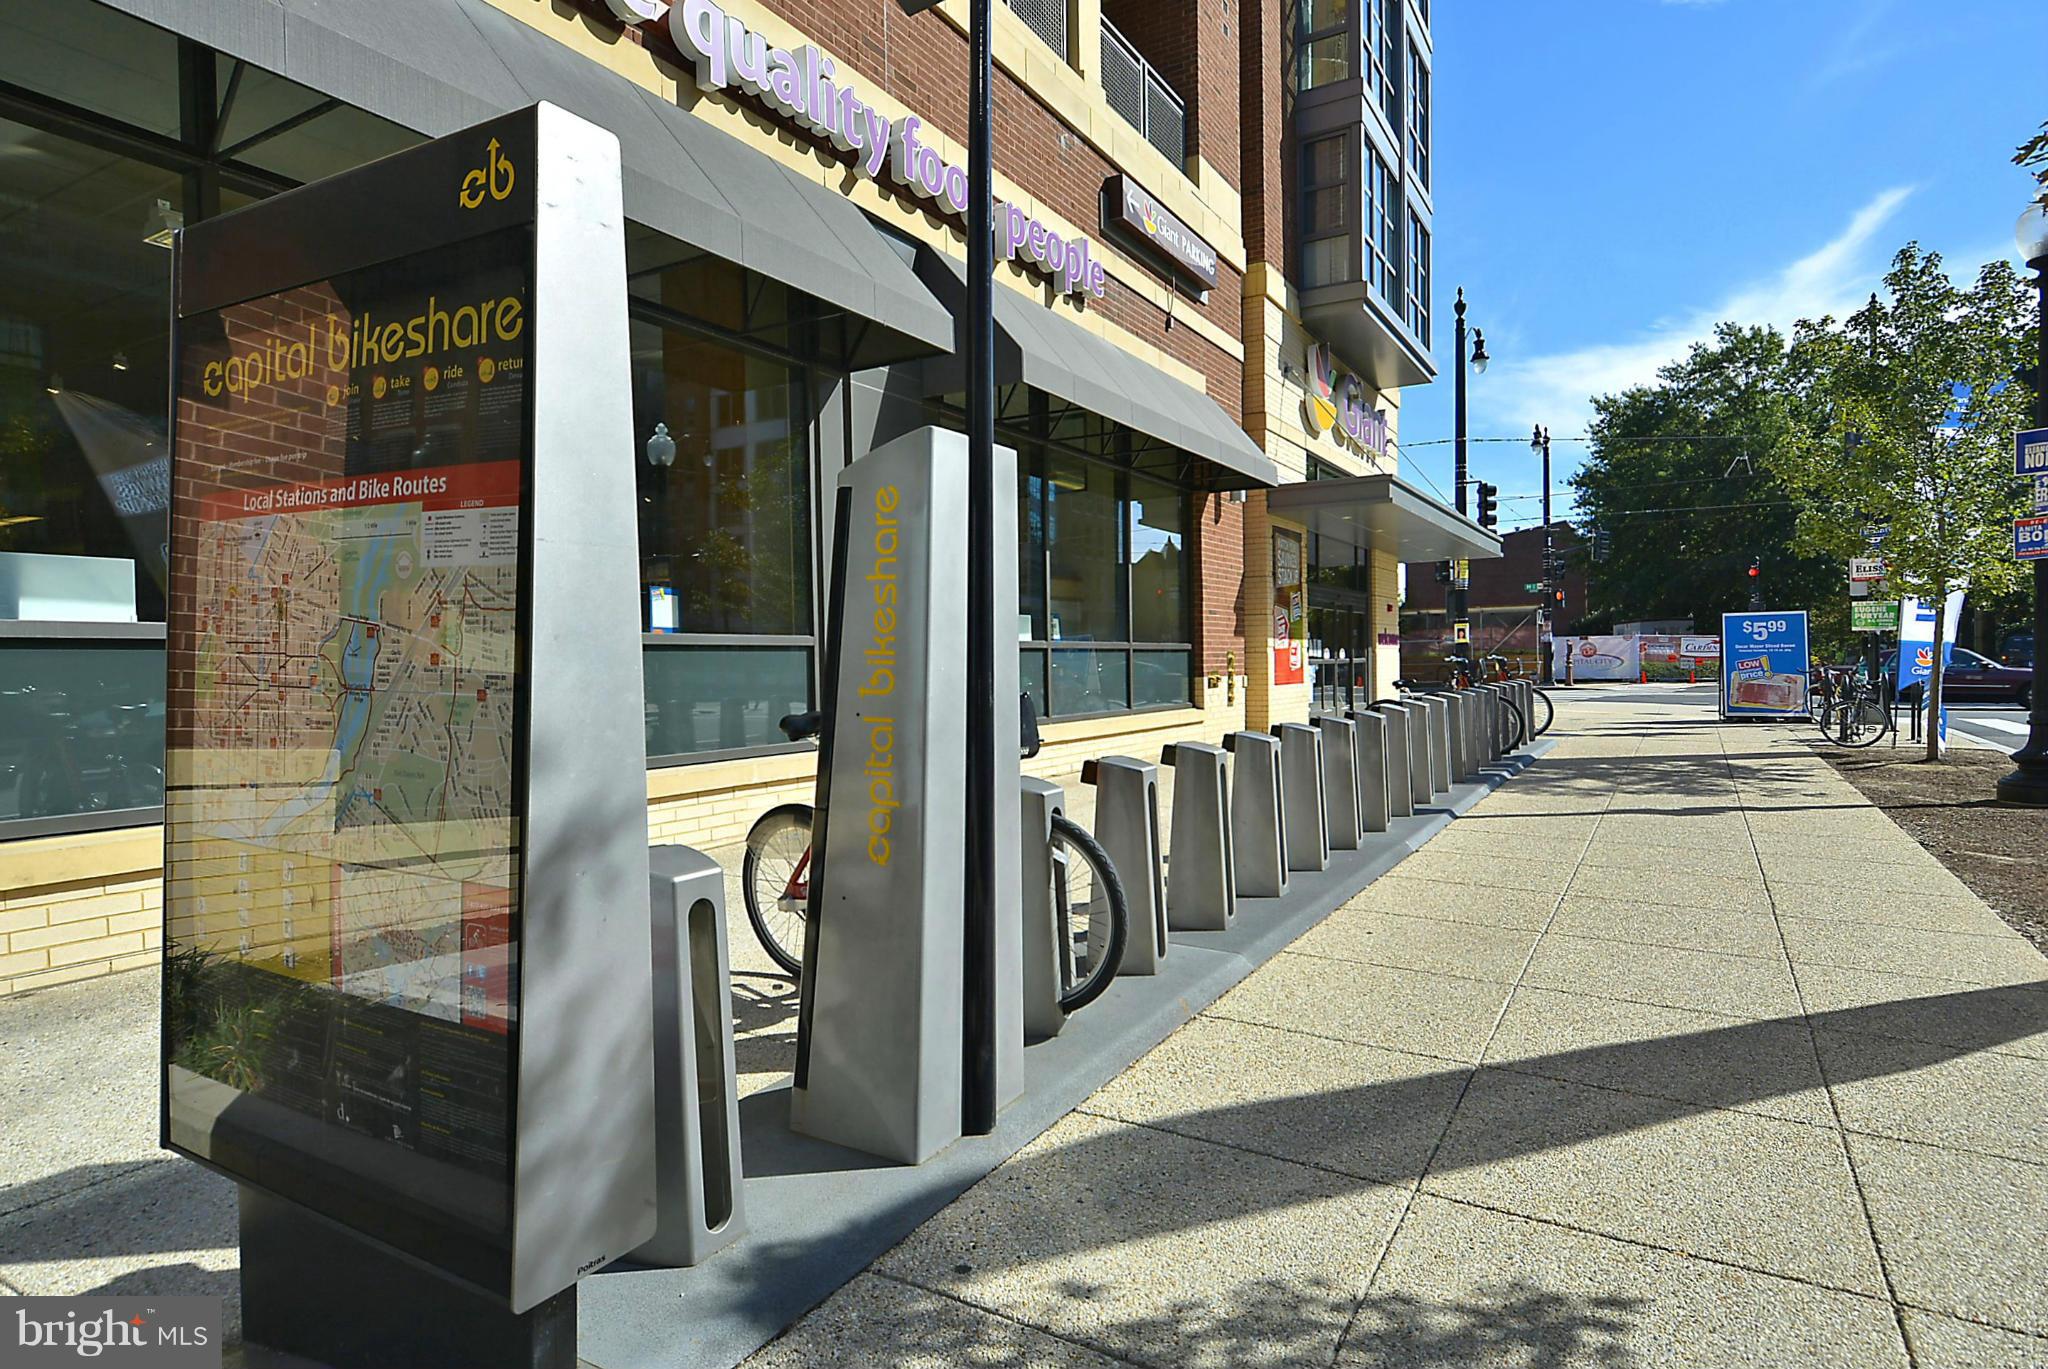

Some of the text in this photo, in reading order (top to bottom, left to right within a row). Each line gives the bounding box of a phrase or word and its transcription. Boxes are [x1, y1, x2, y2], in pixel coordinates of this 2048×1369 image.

[683, 0, 1105, 299] quality foo people
[1157, 216, 1215, 275] Giant PARKING
[204, 296, 524, 404] capital bikeshare
[390, 374, 411, 390] take
[443, 364, 463, 381] ride
[1344, 372, 1387, 457] Giant
[243, 474, 447, 511] Local Stations and Bike Routes
[460, 499, 484, 509] LEGEND
[858, 483, 901, 866] capital bikeshare
[1738, 659, 1760, 669] LOW
[1740, 670, 1763, 680] price
[576, 1254, 606, 1276] Poitras
